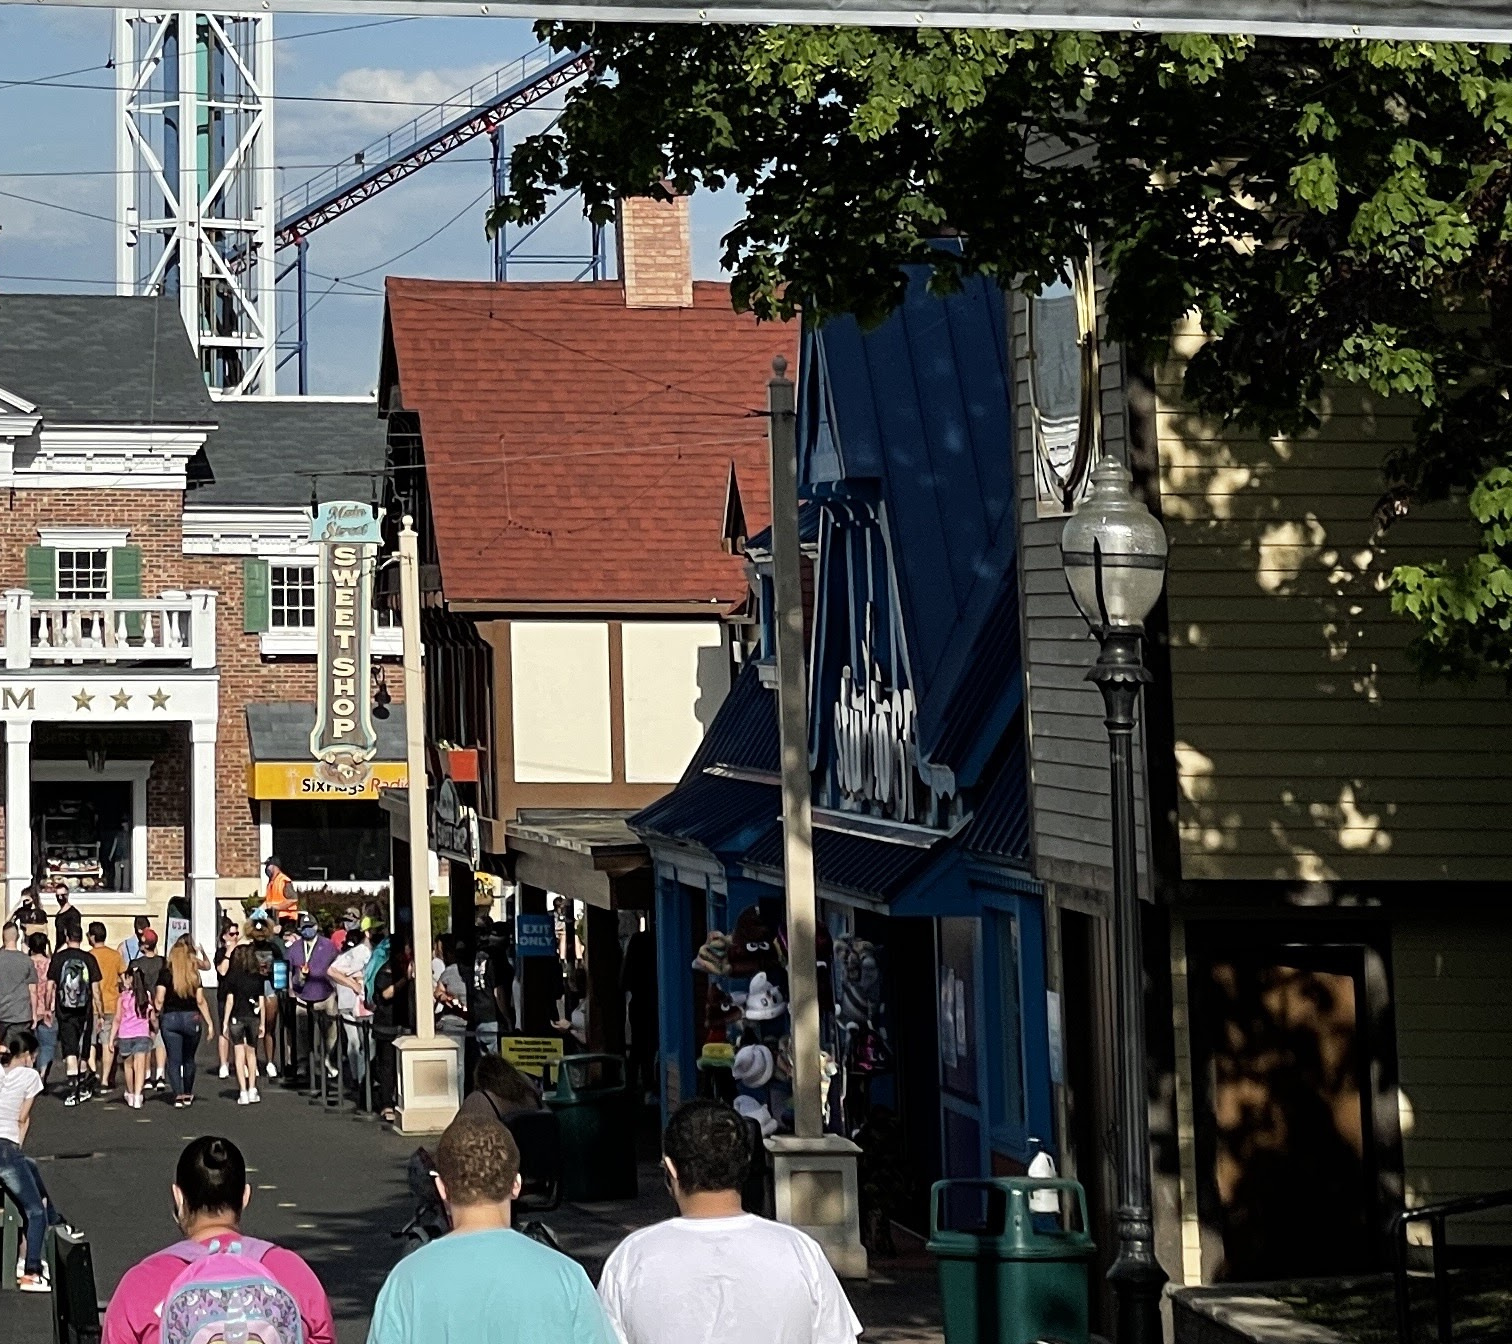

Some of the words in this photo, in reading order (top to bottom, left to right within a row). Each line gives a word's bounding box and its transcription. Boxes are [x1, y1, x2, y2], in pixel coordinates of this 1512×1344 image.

[331, 546, 361, 649] SWEET
[331, 657, 356, 738] SHOP
[519, 935, 554, 947] ONLY
[521, 923, 551, 935] EXIT
